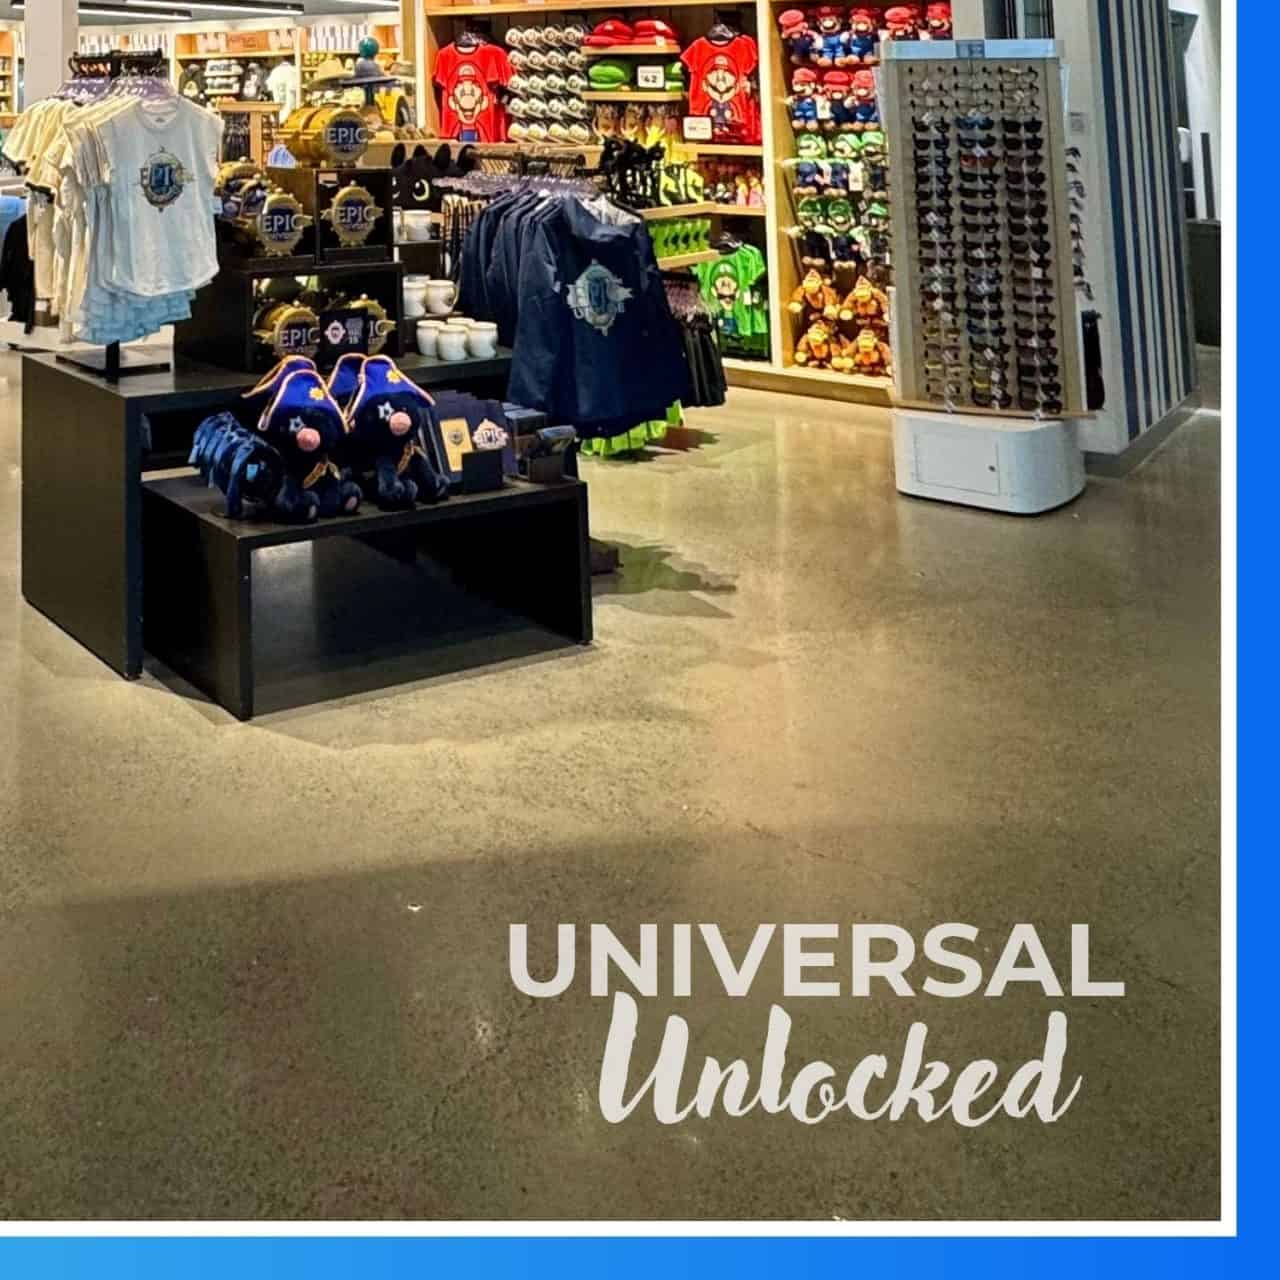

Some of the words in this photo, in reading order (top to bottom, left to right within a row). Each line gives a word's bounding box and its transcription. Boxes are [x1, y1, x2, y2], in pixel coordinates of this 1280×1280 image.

[324, 127, 369, 144] EPIC
[262, 213, 304, 233] EPIC
[336, 205, 376, 224] EPIC
[279, 326, 320, 347] EPIC
